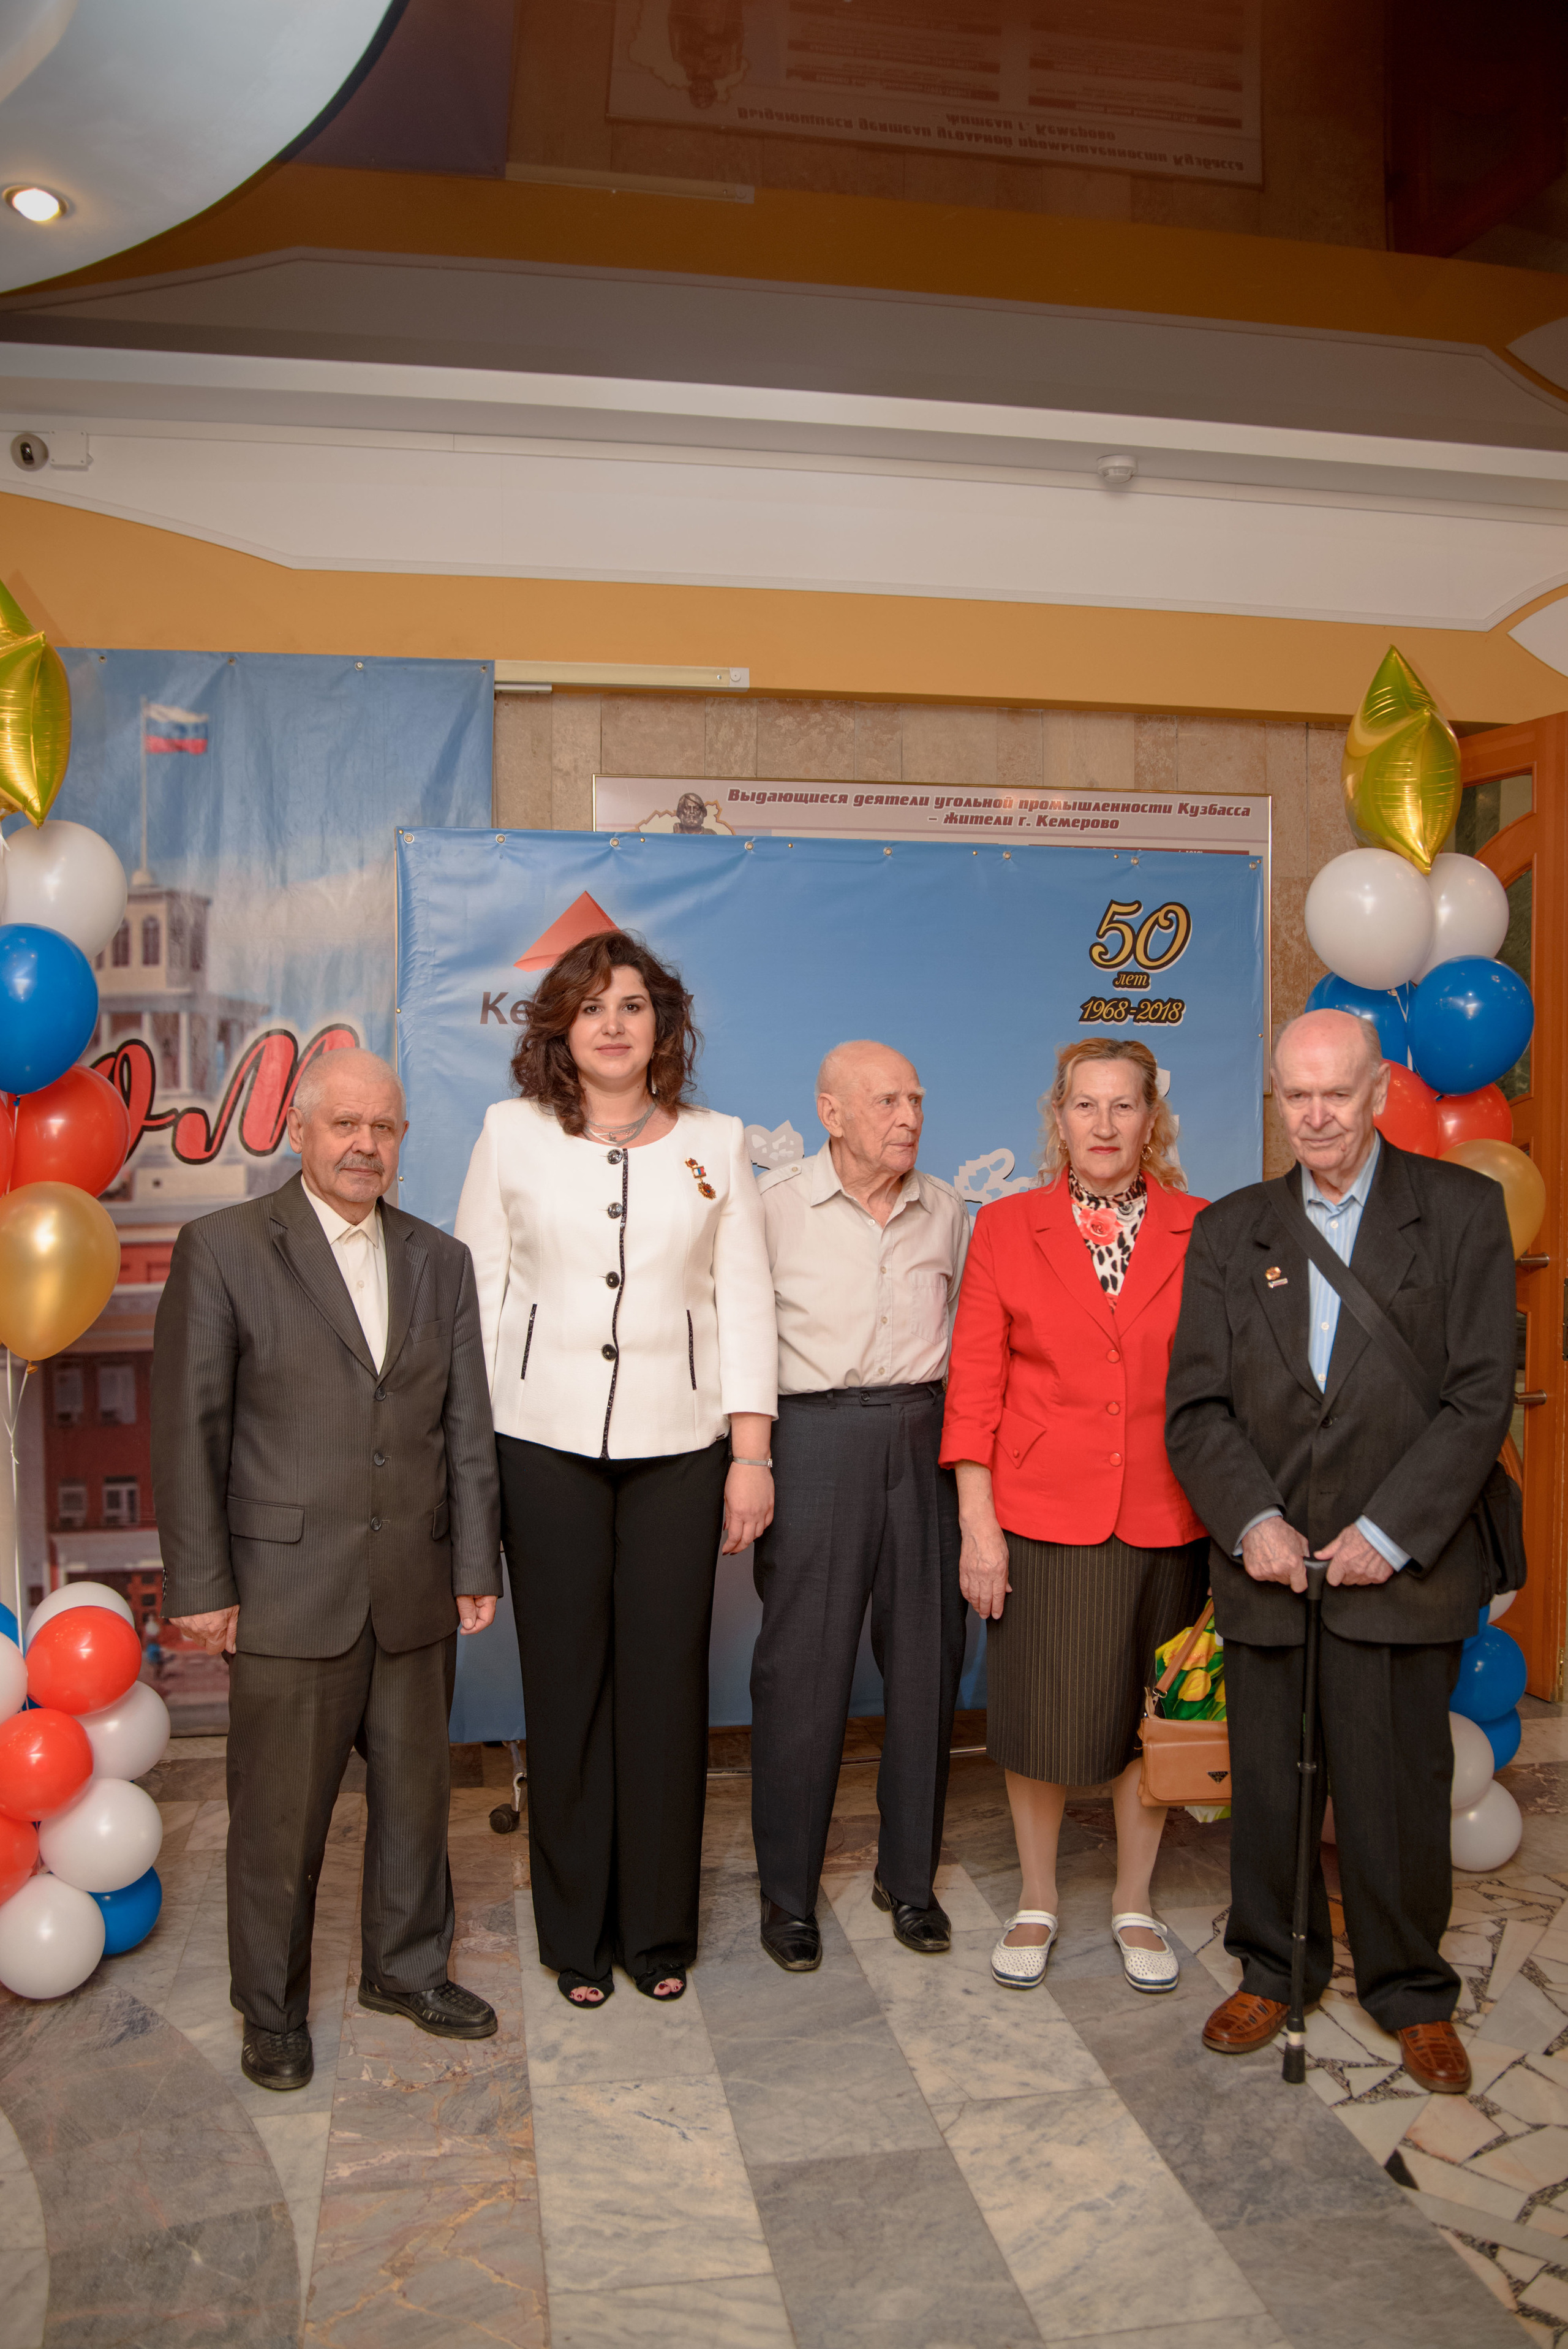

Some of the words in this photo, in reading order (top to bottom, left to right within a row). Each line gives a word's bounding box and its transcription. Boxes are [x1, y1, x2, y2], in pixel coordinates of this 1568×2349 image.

[727, 788, 848, 805] Выдающиеся
[853, 793, 930, 807] деятели
[934, 796, 1014, 809] угольной
[1018, 798, 1173, 814] промышленности
[1177, 802, 1251, 817] Кузбасса
[943, 812, 1014, 826] жители
[1018, 815, 1031, 826] г.
[1036, 814, 1120, 831] Кемерово
[1089, 899, 1191, 971] 50
[1114, 972, 1150, 988] лет
[1079, 997, 1185, 1023] 1968-2018
